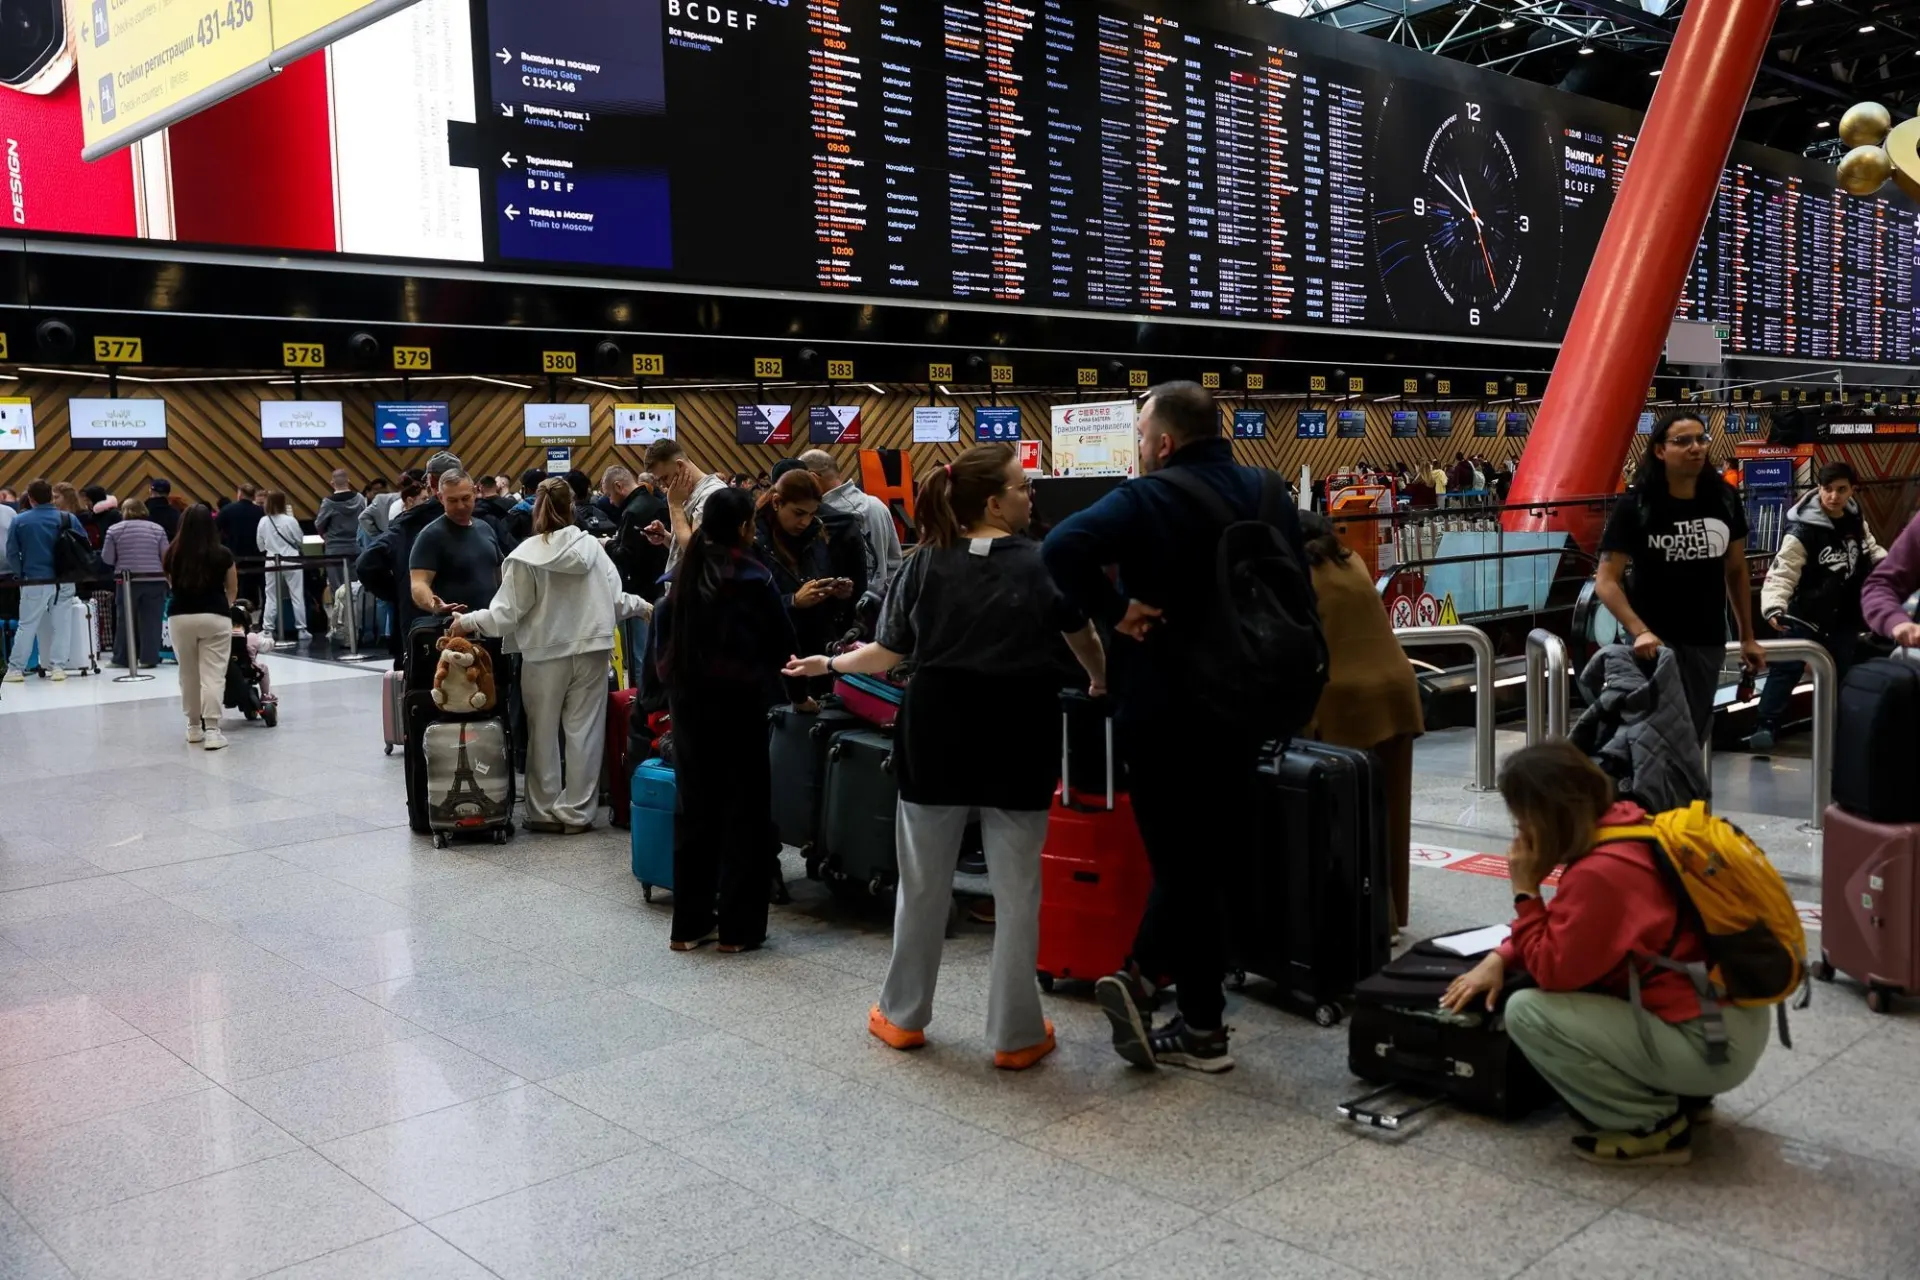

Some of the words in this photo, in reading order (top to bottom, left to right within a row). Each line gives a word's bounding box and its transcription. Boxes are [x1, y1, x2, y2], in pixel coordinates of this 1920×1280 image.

[880, 4, 898, 14] Magas
[668, 0, 681, 16] B
[686, 2, 700, 20] C
[707, 6, 721, 24] D
[727, 9, 738, 28] E
[746, 13, 757, 31] F
[880, 18, 895, 27] Sochi
[668, 26, 682, 36] Все
[683, 30, 723, 44] терминалы
[117, 64, 144, 89] Стойки
[144, 33, 195, 78] регистрации
[197, 0, 254, 48] 431-436
[669, 38, 678, 46] All
[679, 39, 712, 52] terminals
[823, 38, 847, 50] 08:00
[1144, 38, 1161, 50] 12:00
[521, 51, 554, 65] Выходы
[555, 58, 566, 67] на
[567, 61, 601, 74] посадку
[521, 64, 558, 78] Boarding
[560, 70, 582, 81] Gates
[532, 77, 576, 93] 124-146
[882, 76, 911, 88] Kaliningrad
[999, 85, 1018, 97] 11:00
[563, 110, 584, 120] этаж
[585, 112, 591, 121] 1
[883, 105, 912, 116] Casablanca
[1465, 102, 1481, 122] 12
[524, 117, 557, 129] Arrivals,
[558, 120, 577, 131] floor
[579, 124, 584, 132] 1
[884, 120, 898, 128] Perm
[884, 134, 911, 145] Volgograd
[827, 142, 850, 153] 09:00
[1565, 146, 1595, 163] Вылеты
[525, 155, 573, 169] Терминалы
[526, 167, 565, 179] Terminals
[1565, 160, 1606, 179] Departures
[6, 137, 25, 225] DESIGN
[527, 178, 536, 189] B
[540, 179, 550, 190] D
[553, 181, 561, 192] E
[566, 182, 574, 193] F
[885, 177, 896, 185] Ufa
[1565, 178, 1570, 189] B
[1571, 180, 1576, 191] C
[1577, 181, 1583, 192] D
[1584, 182, 1589, 193] E
[1590, 184, 1595, 194] F
[1413, 197, 1425, 216] 9
[528, 207, 556, 219] Поезд
[563, 210, 594, 222] Москву
[529, 219, 550, 229] Train
[551, 221, 560, 229] to
[562, 222, 594, 232] Moscow
[887, 220, 916, 230] Kaliningrad
[1519, 215, 1529, 232] 3
[888, 235, 902, 243] Sochi
[1149, 238, 1166, 247] 13:00
[832, 246, 854, 256] 10:00
[889, 263, 905, 271] Minsk
[889, 278, 919, 287] Chelyabinsk
[1469, 308, 1480, 326] 6
[98, 340, 139, 358] 377
[286, 347, 322, 363] 378
[396, 350, 429, 366] 379
[545, 355, 575, 369] 380
[635, 357, 661, 371] 381
[756, 361, 781, 375] 382
[829, 363, 852, 376] 383
[931, 367, 951, 378] 384
[993, 369, 1012, 380] 385
[1079, 371, 1096, 382] 386
[1130, 373, 1147, 383] 387
[1203, 375, 1219, 386] 388
[1248, 376, 1262, 387] 389
[1311, 378, 1325, 389] 390
[1350, 379, 1362, 390] 391
[1404, 380, 1417, 391] 392
[1438, 381, 1450, 392] 393
[1516, 384, 1527, 395] 395
[91, 419, 146, 428] ETIHAD
[279, 420, 326, 428] ETIHAD
[539, 421, 577, 429] ETIHAD
[1054, 425, 1091, 434] Транзитные
[1092, 422, 1131, 432] привилегии
[103, 439, 138, 447] Economy
[288, 438, 320, 447] Economy
[1758, 447, 1790, 455] PACK&FLY
[1673, 519, 1705, 534] THE
[1648, 532, 1707, 549] NORTH
[1666, 545, 1708, 561] FACE
